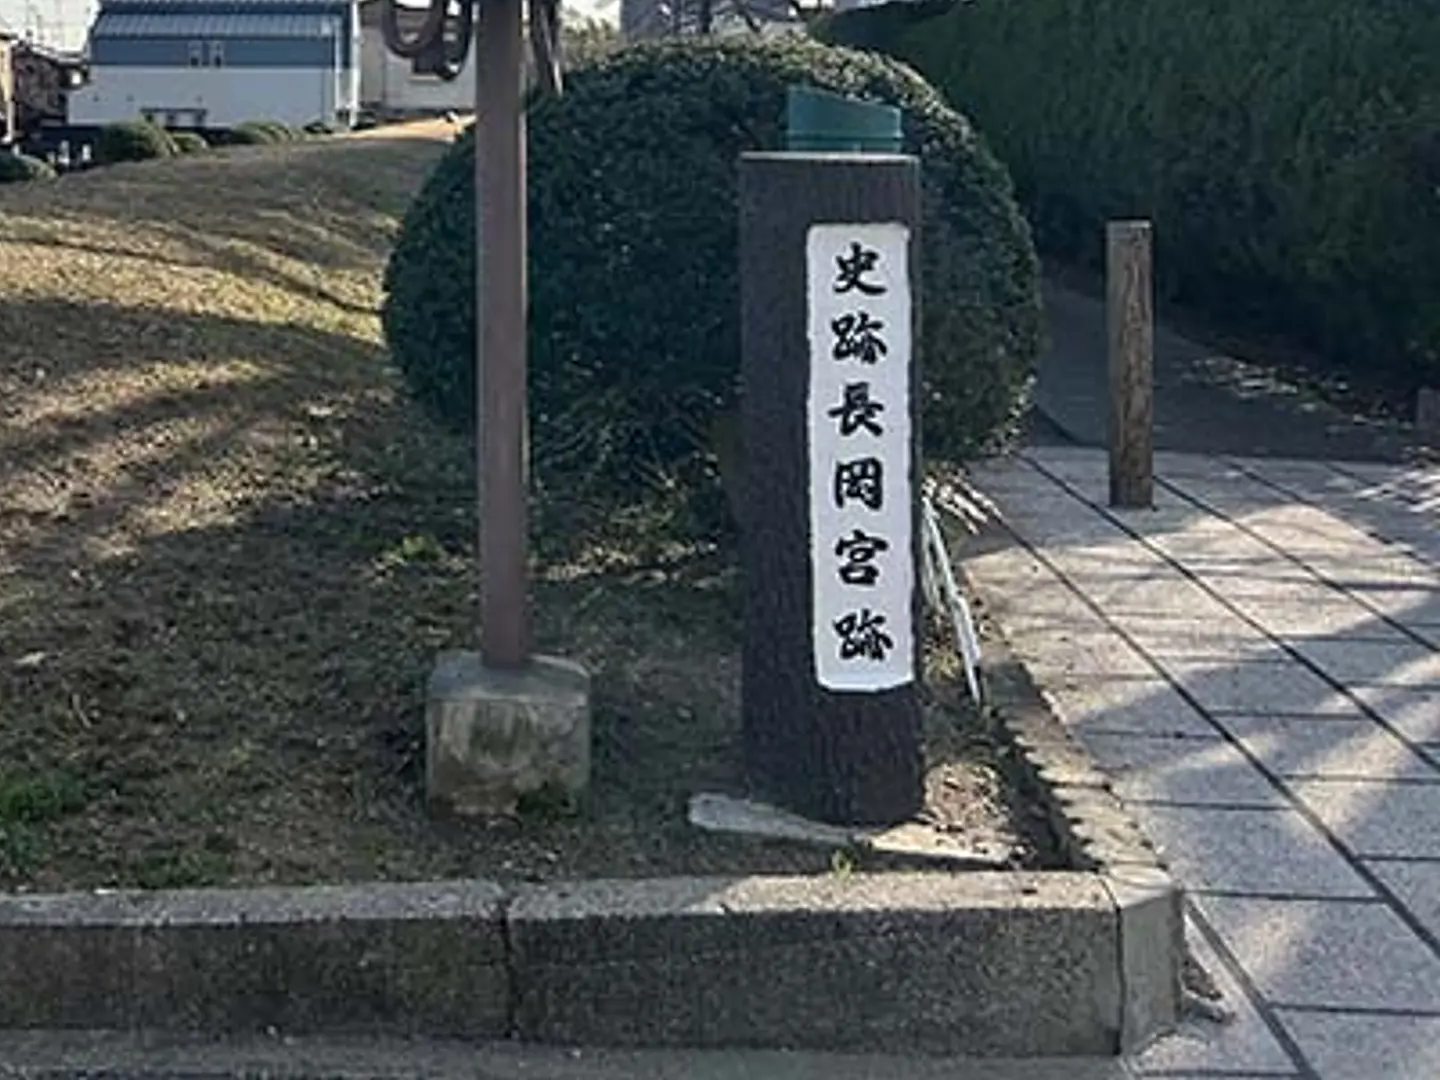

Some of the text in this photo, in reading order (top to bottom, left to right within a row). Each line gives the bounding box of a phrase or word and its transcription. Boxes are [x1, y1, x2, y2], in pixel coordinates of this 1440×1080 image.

[829, 242, 894, 663] 史跡長岡宮跡
